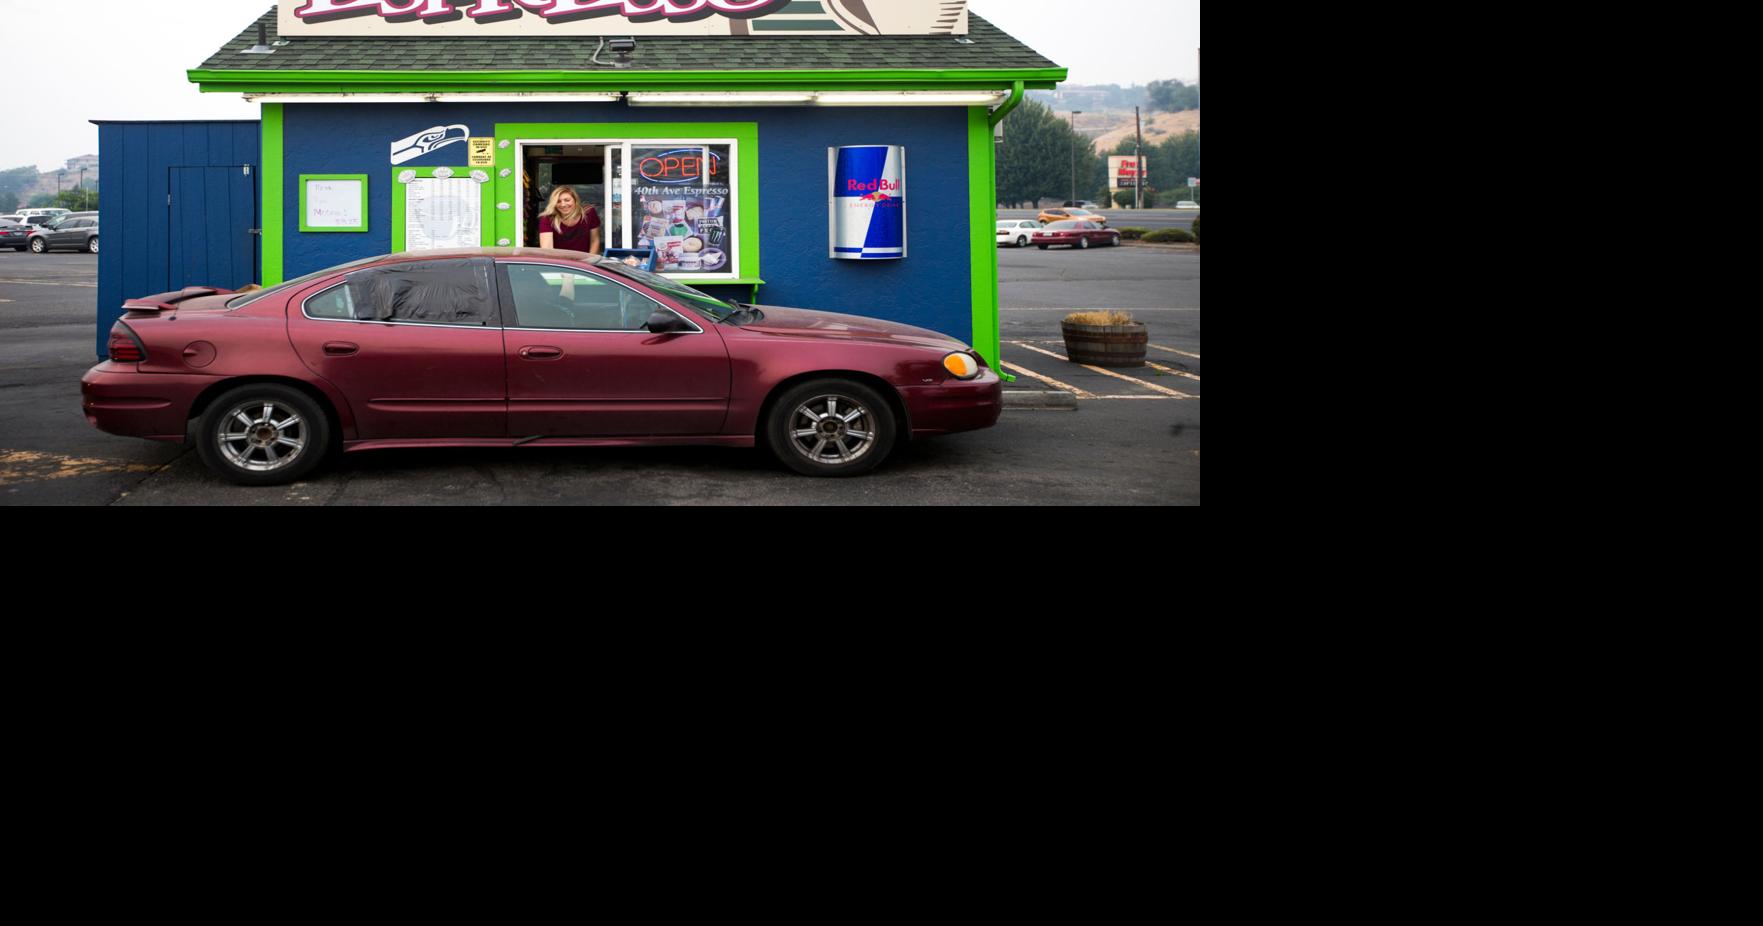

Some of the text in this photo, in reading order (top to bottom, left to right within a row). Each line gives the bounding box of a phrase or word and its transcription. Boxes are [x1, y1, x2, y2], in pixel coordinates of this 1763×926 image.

[640, 156, 717, 177] OPEN
[847, 178, 901, 191] Red Bull
[634, 186, 729, 197] 40th Ave Espresso
